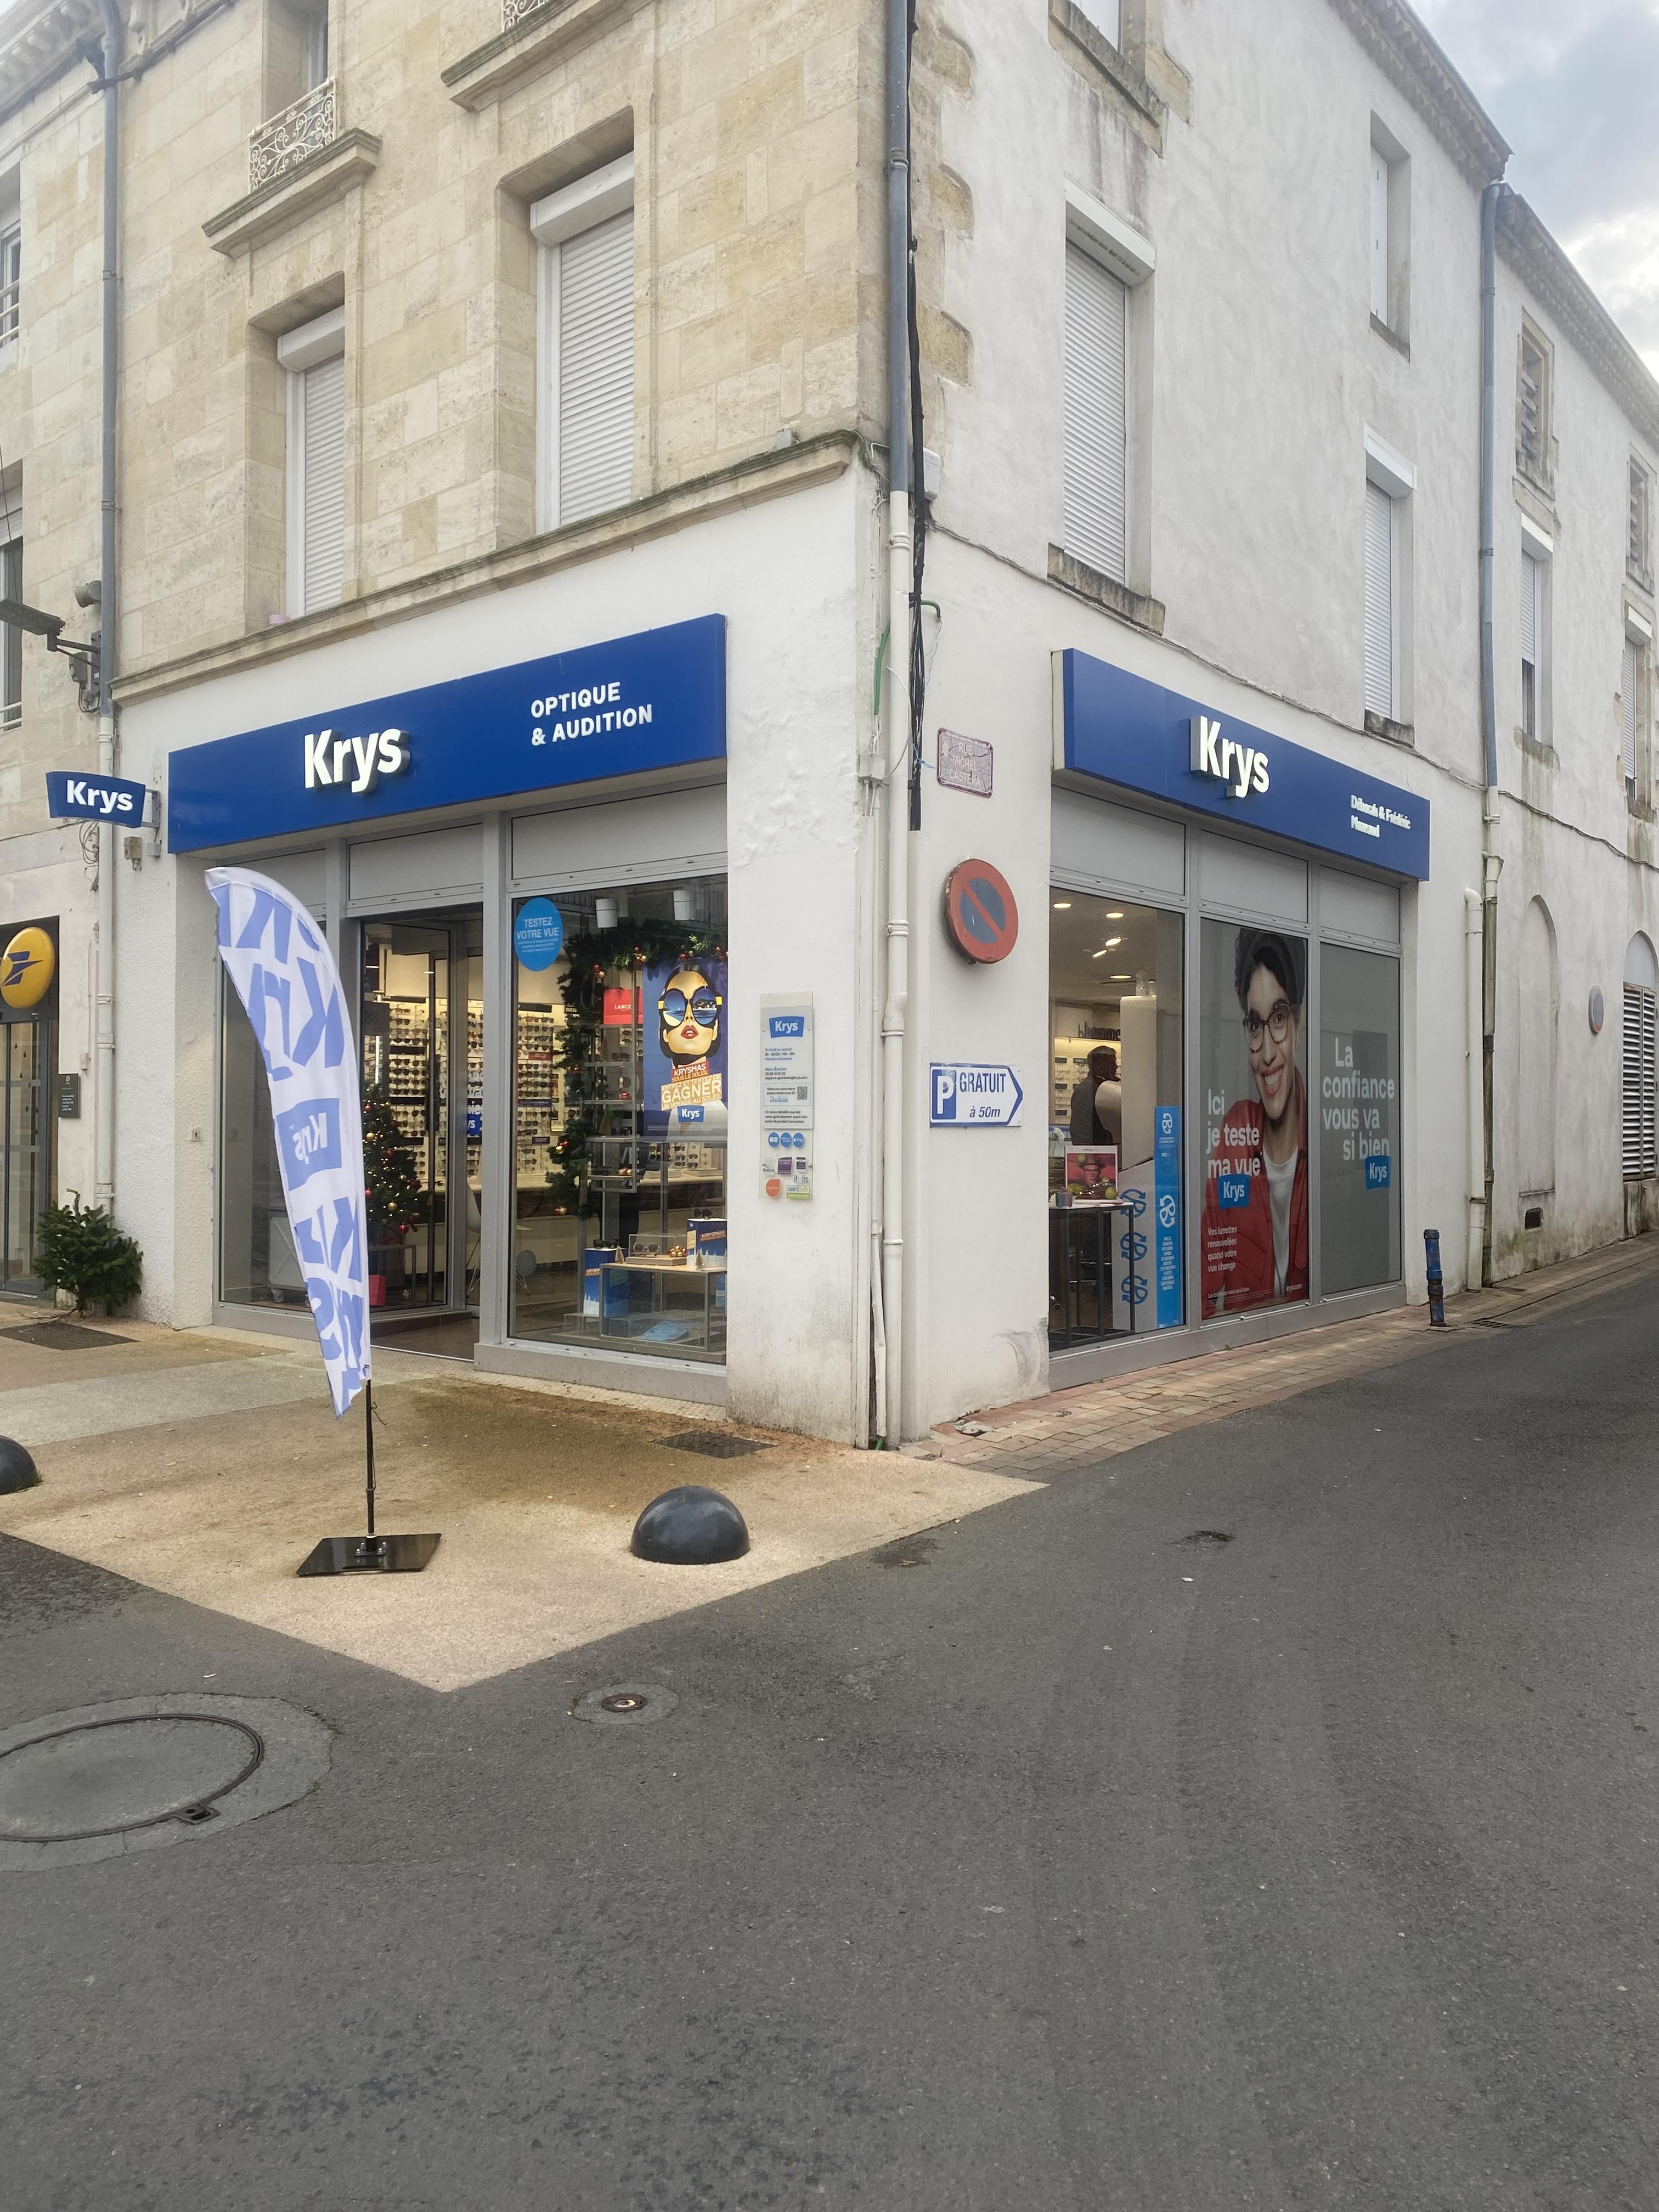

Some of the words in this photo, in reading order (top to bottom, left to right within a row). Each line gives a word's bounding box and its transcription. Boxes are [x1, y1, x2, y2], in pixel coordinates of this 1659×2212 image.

[531, 681, 621, 719] OPTIQUE
[531, 727, 546, 746] &
[552, 704, 653, 742] AUDITION
[958, 742, 974, 755] RUE
[1199, 715, 1270, 798] Krys
[304, 727, 408, 793] Krys
[66, 779, 133, 815] Krys
[1379, 805, 1386, 821] &
[524, 917, 553, 928] TESTEZ
[516, 929, 542, 940] VOTRE
[544, 927, 560, 937] VUE
[775, 1020, 799, 1034] Krys
[1335, 1037, 1354, 1068] La
[674, 1063, 707, 1077] KRYSMAS
[691, 1070, 709, 1079] SOLEIL
[662, 1081, 683, 1091] ENTREZ
[691, 1076, 712, 1085] TENTEZ
[662, 1079, 722, 1104] GAGNER
[937, 1075, 955, 1114] P
[960, 1071, 1006, 1093] GRATUIT
[1322, 1070, 1395, 1099] confiance
[670, 1099, 692, 1108] VOYAGE
[702, 1093, 722, 1102] SOLEIL
[1207, 1088, 1224, 1115] Ici
[681, 1108, 700, 1120] Krys
[969, 1105, 975, 1118] à
[979, 1107, 1001, 1118] 50m
[1322, 1108, 1359, 1130] vous
[1363, 1108, 1380, 1129] va
[1206, 1120, 1221, 1154] je
[1223, 1123, 1260, 1147] teste
[1342, 1131, 1355, 1161] si
[1359, 1131, 1390, 1160] bien
[1207, 1158, 1231, 1179] ma
[1234, 1157, 1261, 1176] vue
[1369, 1161, 1388, 1183] Krys
[1223, 1181, 1245, 1202] Krys
[1207, 1227, 1217, 1236] Vos
[1217, 1226, 1238, 1235] lunettes
[1207, 1237, 1237, 1248] renouvelées
[1207, 1250, 1224, 1262] quand
[1224, 1250, 1237, 1258] votre
[1207, 1265, 1217, 1273] vue
[1217, 1261, 1236, 1272] change
